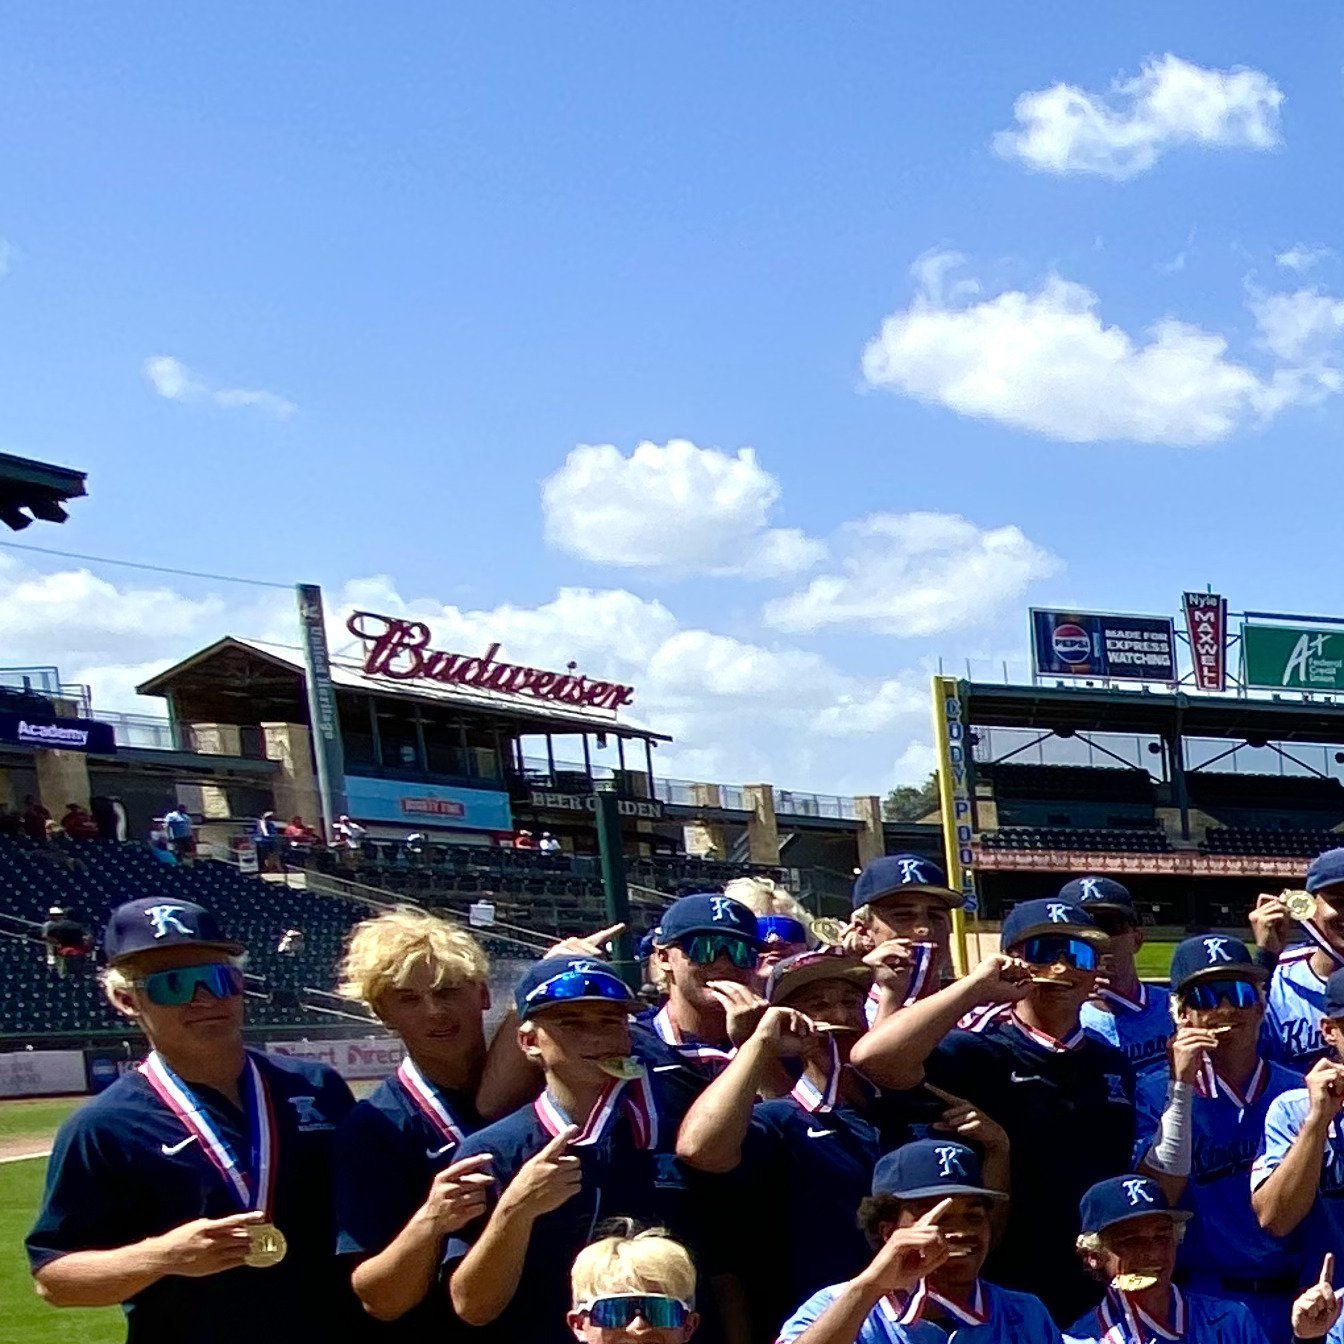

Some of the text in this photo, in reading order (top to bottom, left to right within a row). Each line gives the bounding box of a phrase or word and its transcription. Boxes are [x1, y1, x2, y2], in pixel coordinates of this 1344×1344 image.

[1055, 640, 1089, 648] PEPSI
[1105, 629, 1168, 641] MADE FOR
[1106, 640, 1170, 652] EXPRESS
[1194, 611, 1217, 688] MAXWELL
[346, 610, 634, 709] Budweiser
[1108, 651, 1171, 666] WATCHING
[1282, 634, 1332, 685] A+
[18, 720, 88, 744] Academy
[531, 791, 584, 809] BEER
